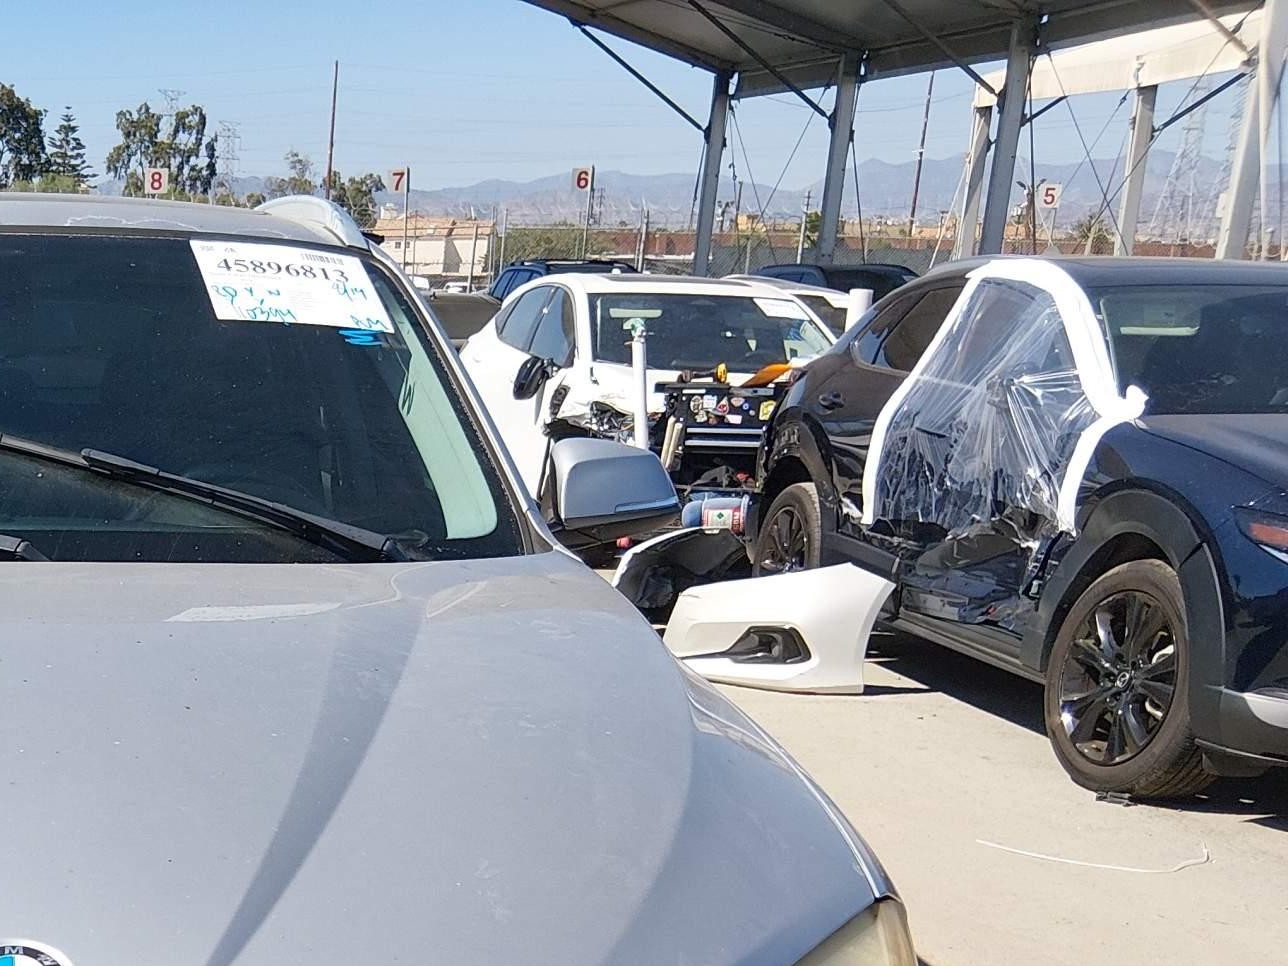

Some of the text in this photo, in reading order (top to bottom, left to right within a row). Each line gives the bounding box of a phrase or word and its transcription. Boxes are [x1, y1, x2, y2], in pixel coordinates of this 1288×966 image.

[150, 171, 163, 191] 8
[392, 172, 405, 191] 7
[576, 170, 589, 189] 6
[1043, 187, 1056, 205] 5
[216, 257, 351, 283] 45896813
